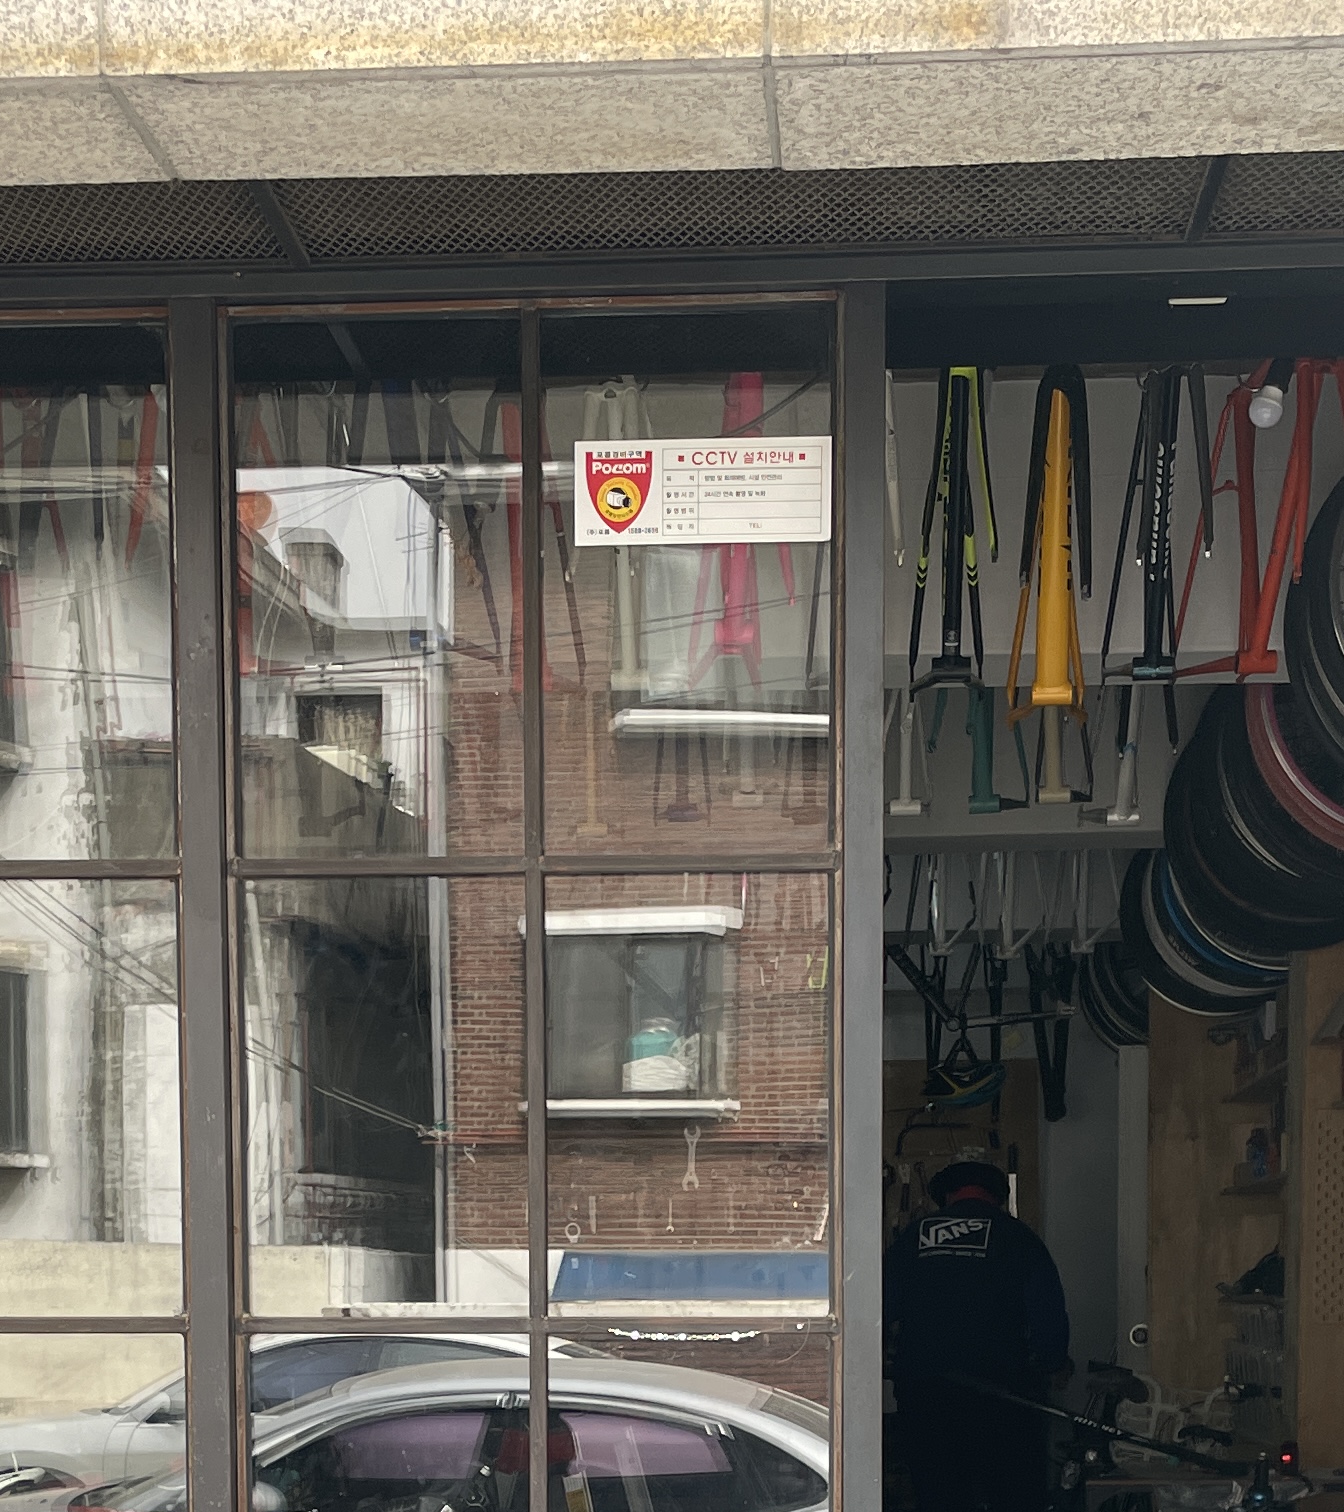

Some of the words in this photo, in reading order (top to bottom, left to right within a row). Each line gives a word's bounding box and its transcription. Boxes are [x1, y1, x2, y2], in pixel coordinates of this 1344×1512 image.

[691, 450, 738, 466] CCTV
[743, 451, 794, 464] 설치안내
[920, 1218, 986, 1248] VANS
